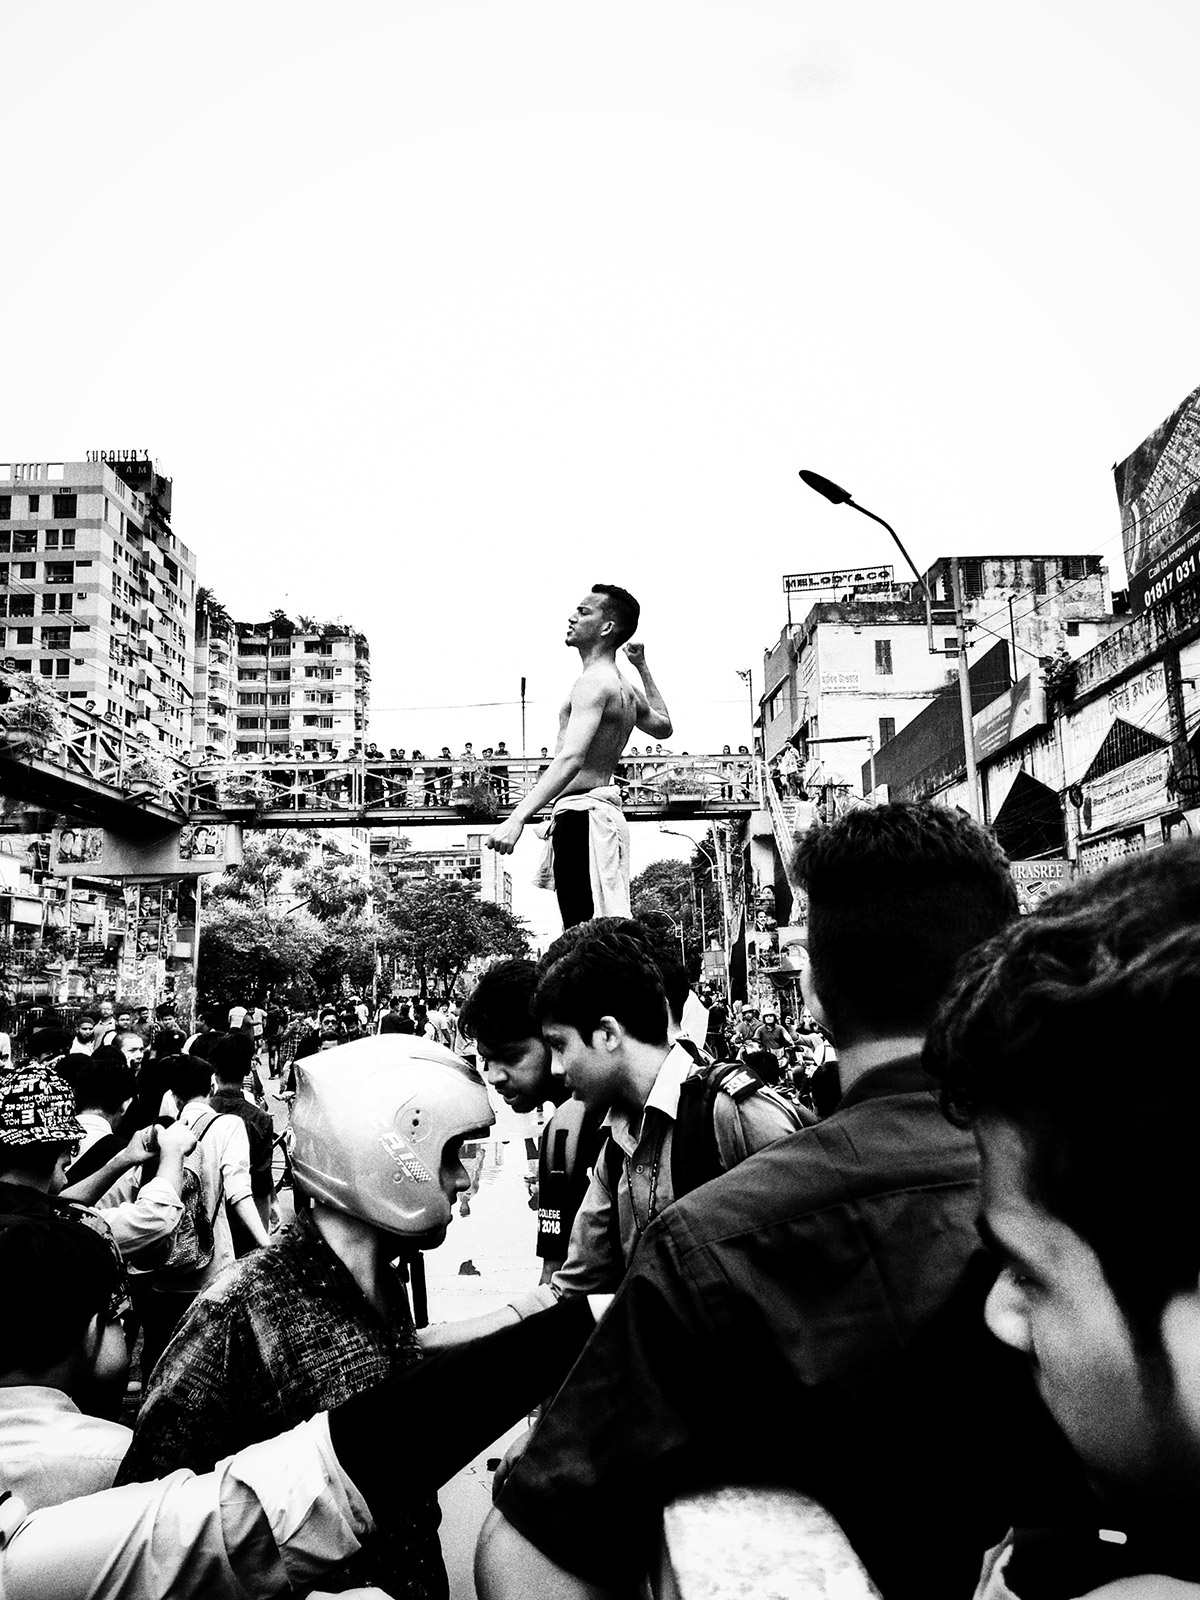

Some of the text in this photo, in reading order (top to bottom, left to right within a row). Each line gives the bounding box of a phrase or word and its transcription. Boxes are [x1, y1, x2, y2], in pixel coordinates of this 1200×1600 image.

[86, 449, 149, 462] SURAIYA'S
[1148, 562, 1160, 579] Call
[1160, 558, 1168, 570] to
[1168, 543, 1186, 564] know
[1144, 555, 1195, 607] 01817 031
[1146, 773, 1162, 785] Store
[541, 1219, 561, 1235] 2018
